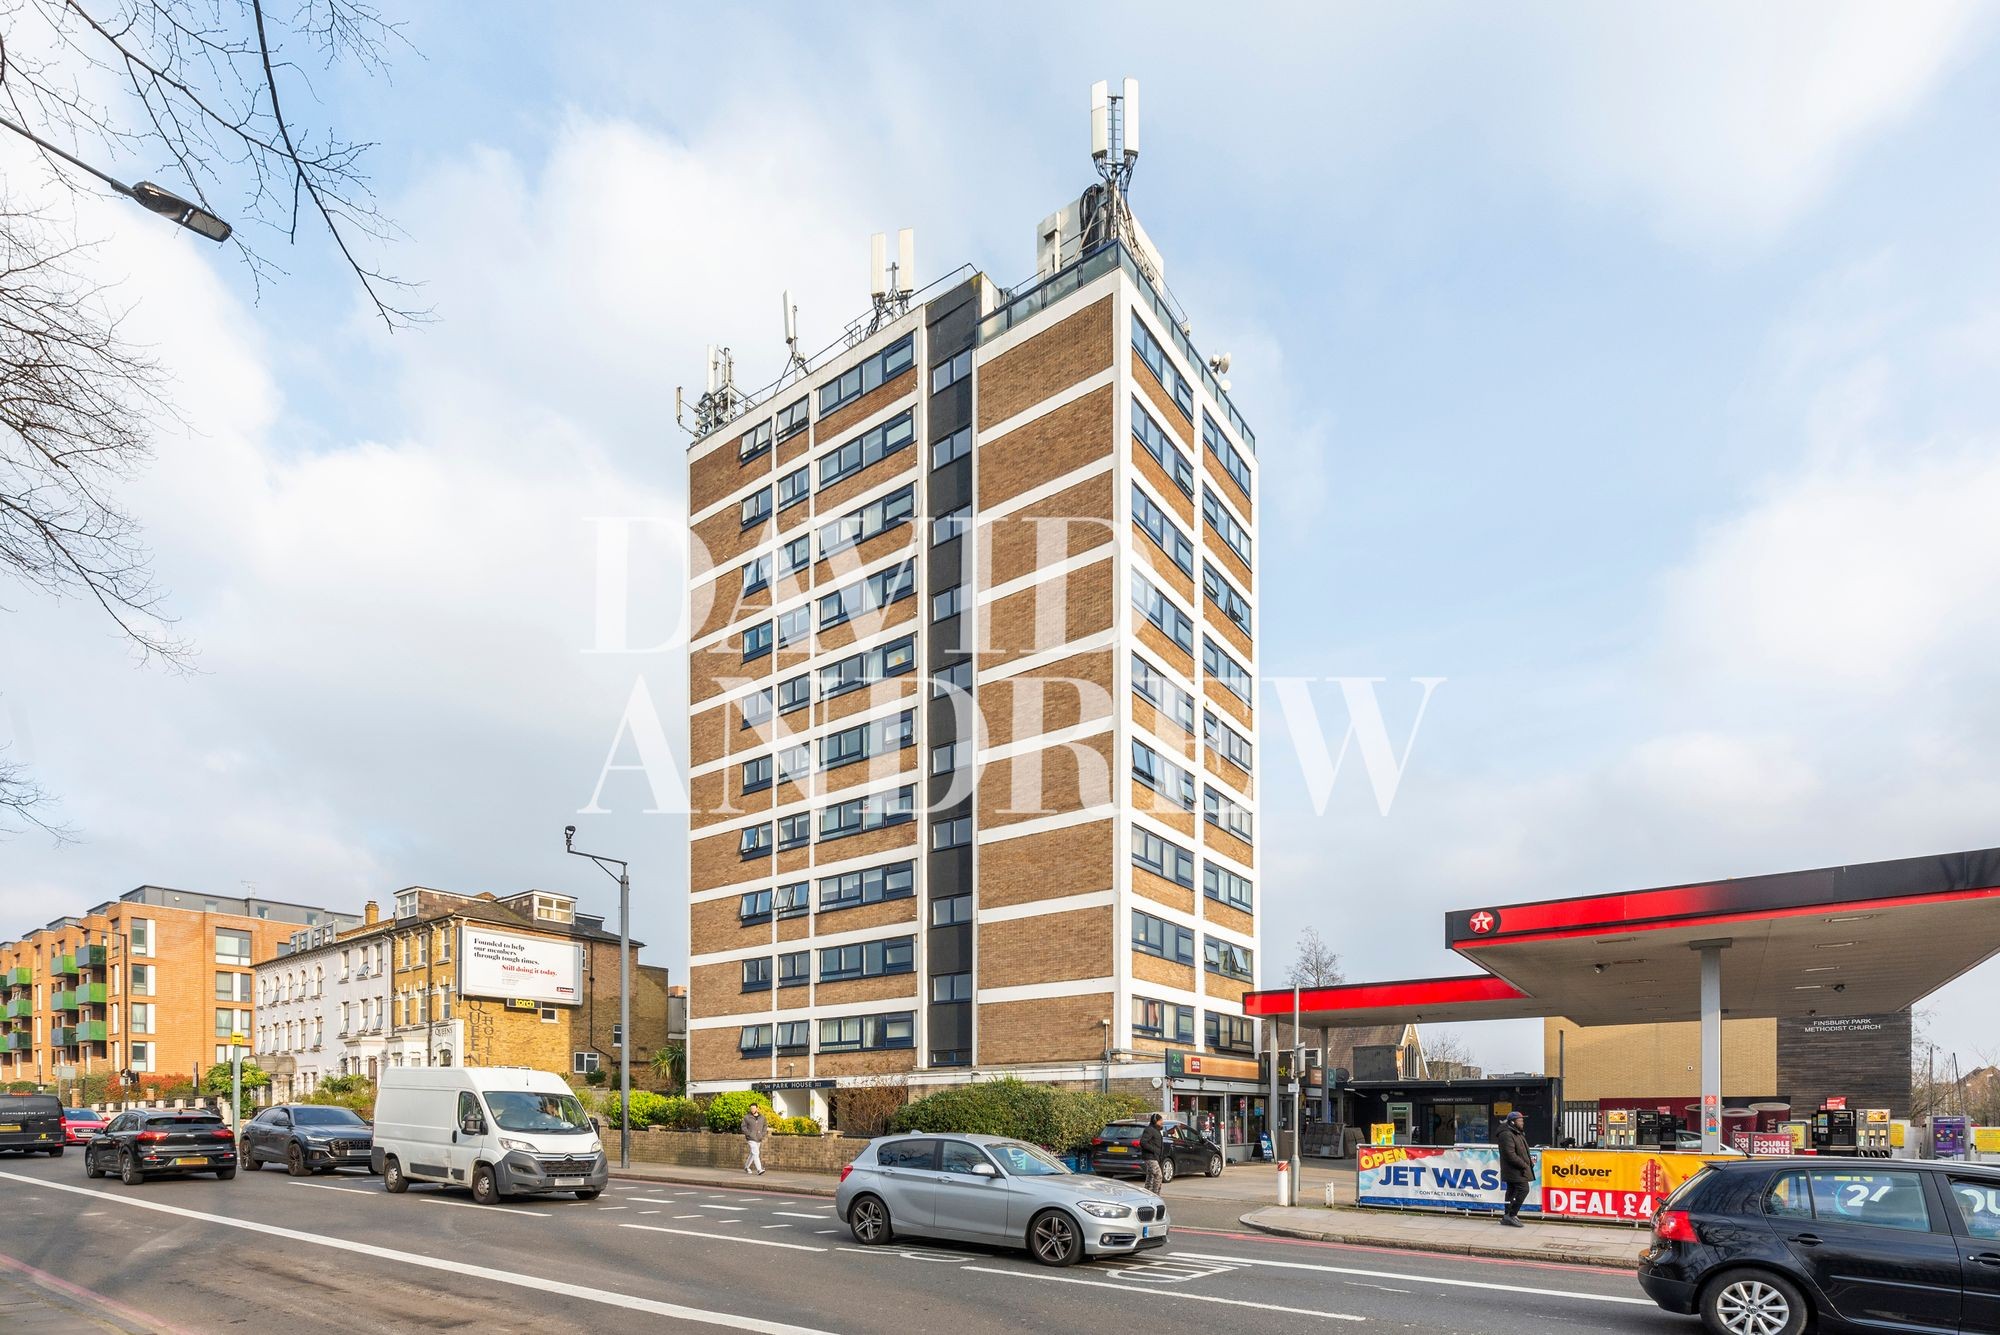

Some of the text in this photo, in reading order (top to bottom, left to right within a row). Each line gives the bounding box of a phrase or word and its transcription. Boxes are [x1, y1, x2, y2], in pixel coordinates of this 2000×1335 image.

[474, 938, 502, 947] Founded
[511, 943, 525, 951] help
[474, 951, 539, 965] through tough times.
[516, 966, 533, 974] doing
[540, 969, 557, 977] today.
[1360, 1147, 1408, 1169] OPEN
[1379, 1166, 1426, 1187] JET
[1551, 1163, 1612, 1178] Rollover
[1549, 1189, 1618, 1215] DEAL
